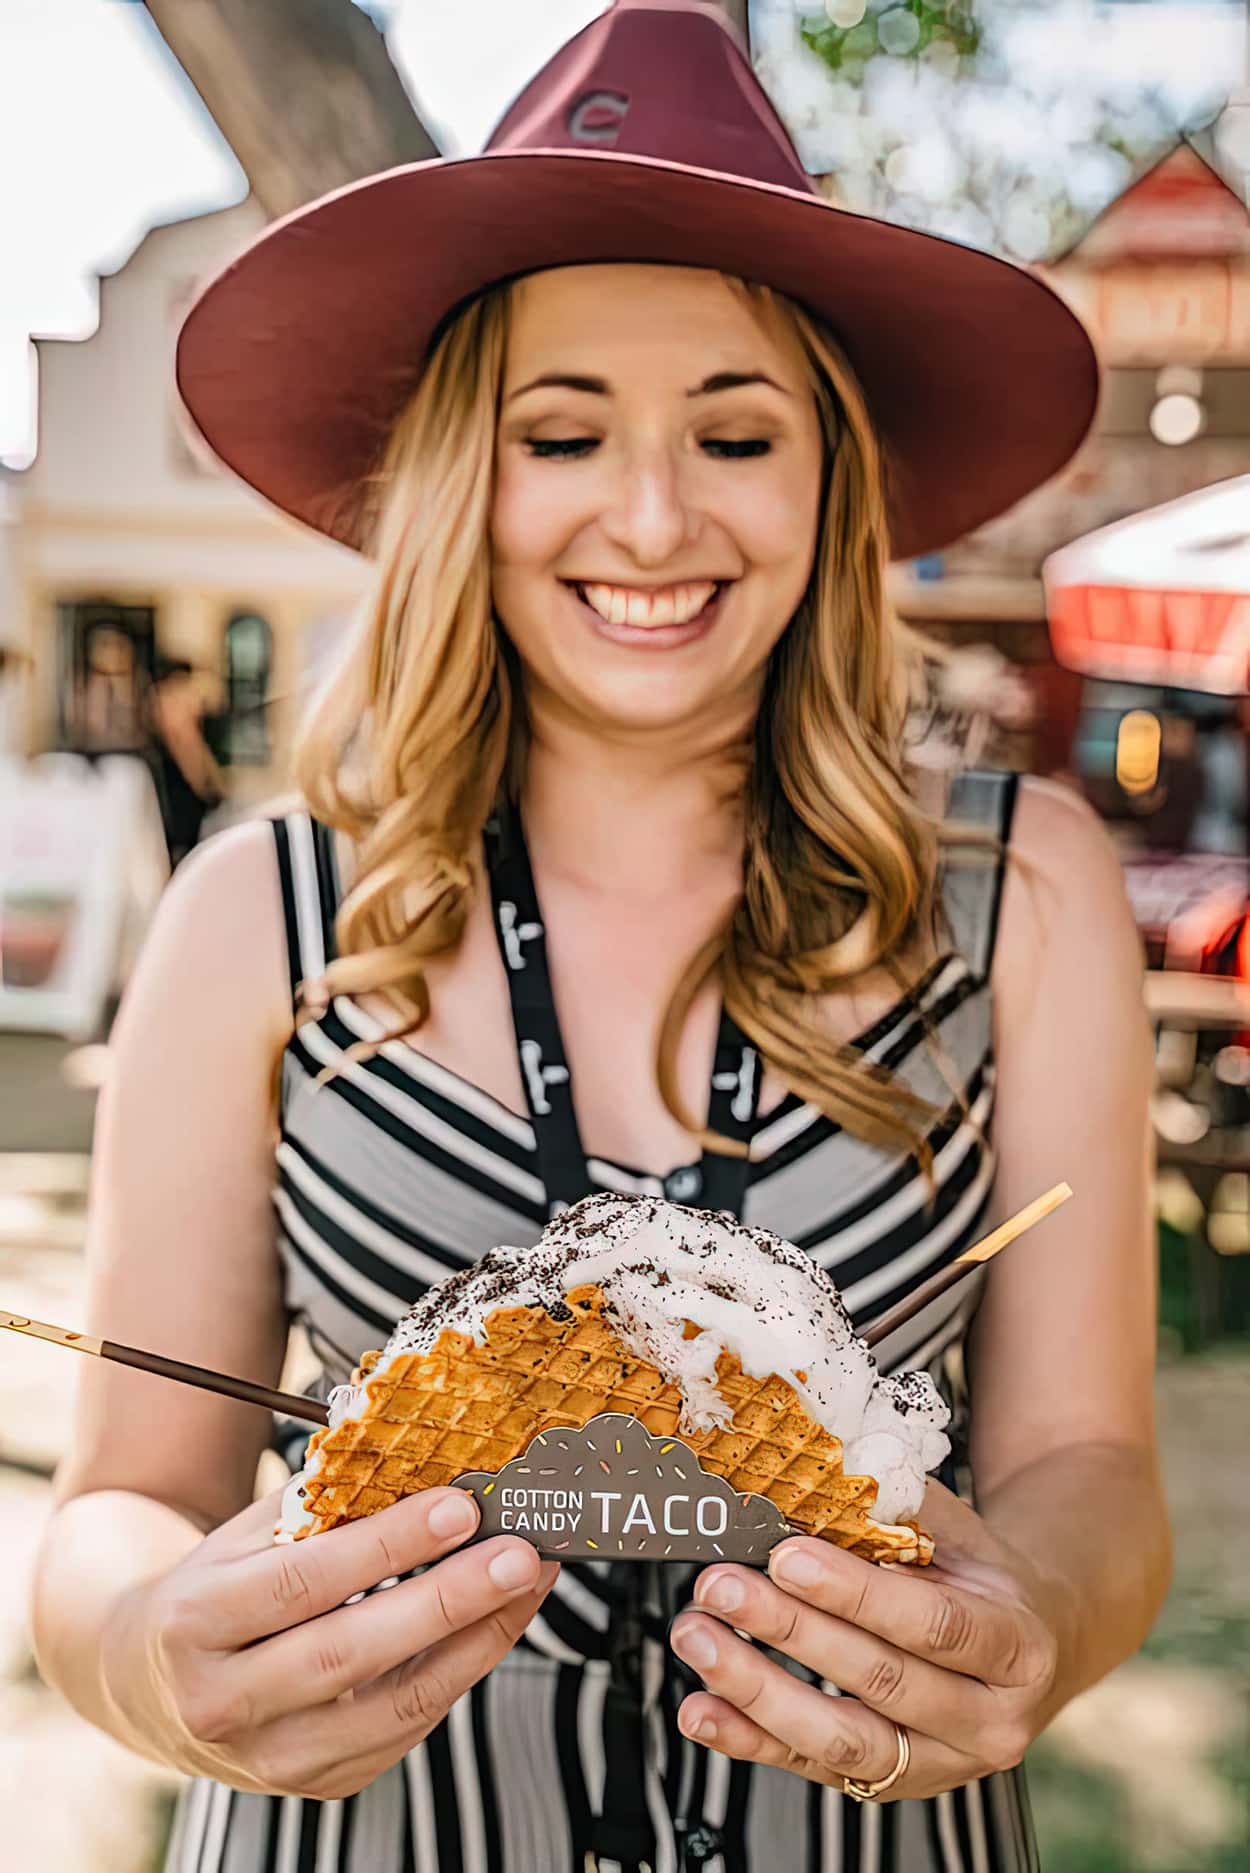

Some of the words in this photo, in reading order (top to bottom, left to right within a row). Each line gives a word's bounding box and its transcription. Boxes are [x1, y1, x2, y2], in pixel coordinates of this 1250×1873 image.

[500, 1488, 583, 1510] COTTON
[500, 1510, 582, 1533] CANDY
[591, 1492, 728, 1537] TACO
